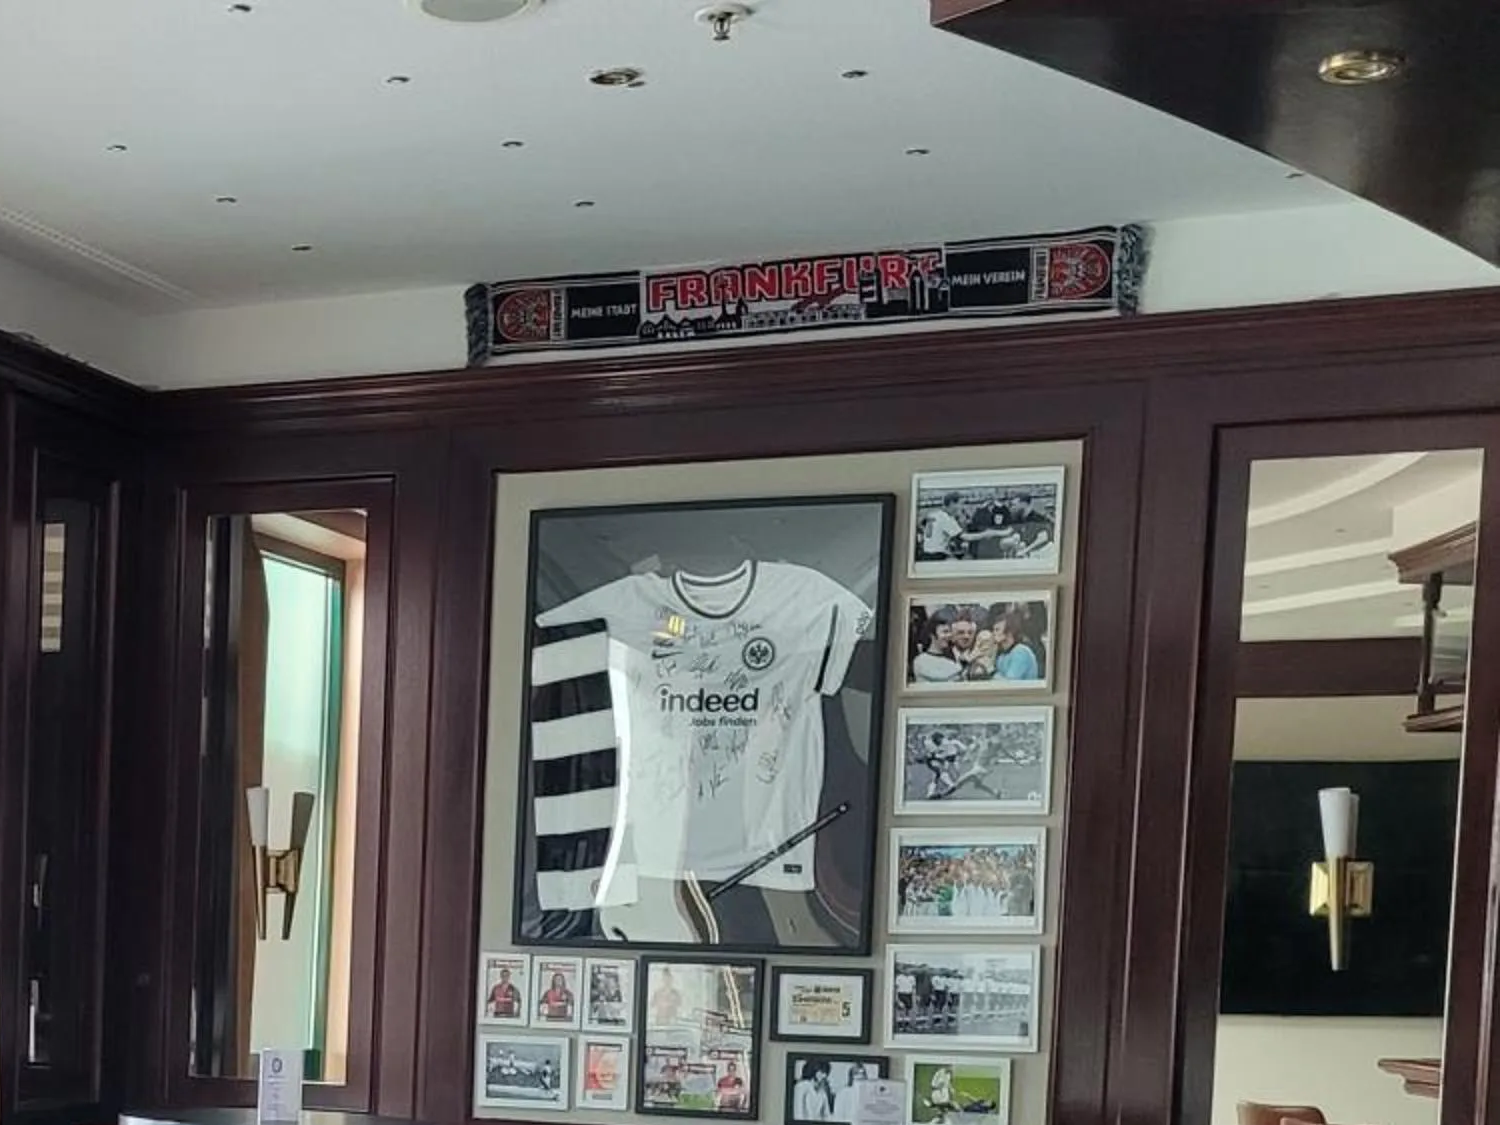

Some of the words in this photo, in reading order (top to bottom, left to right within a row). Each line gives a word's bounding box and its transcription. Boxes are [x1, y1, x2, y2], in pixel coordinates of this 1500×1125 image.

[951, 273, 980, 286] MEIN
[983, 270, 1026, 284] VEREIN
[570, 305, 603, 318] MEINE
[606, 302, 636, 317] STADT
[660, 688, 759, 712] indeed
